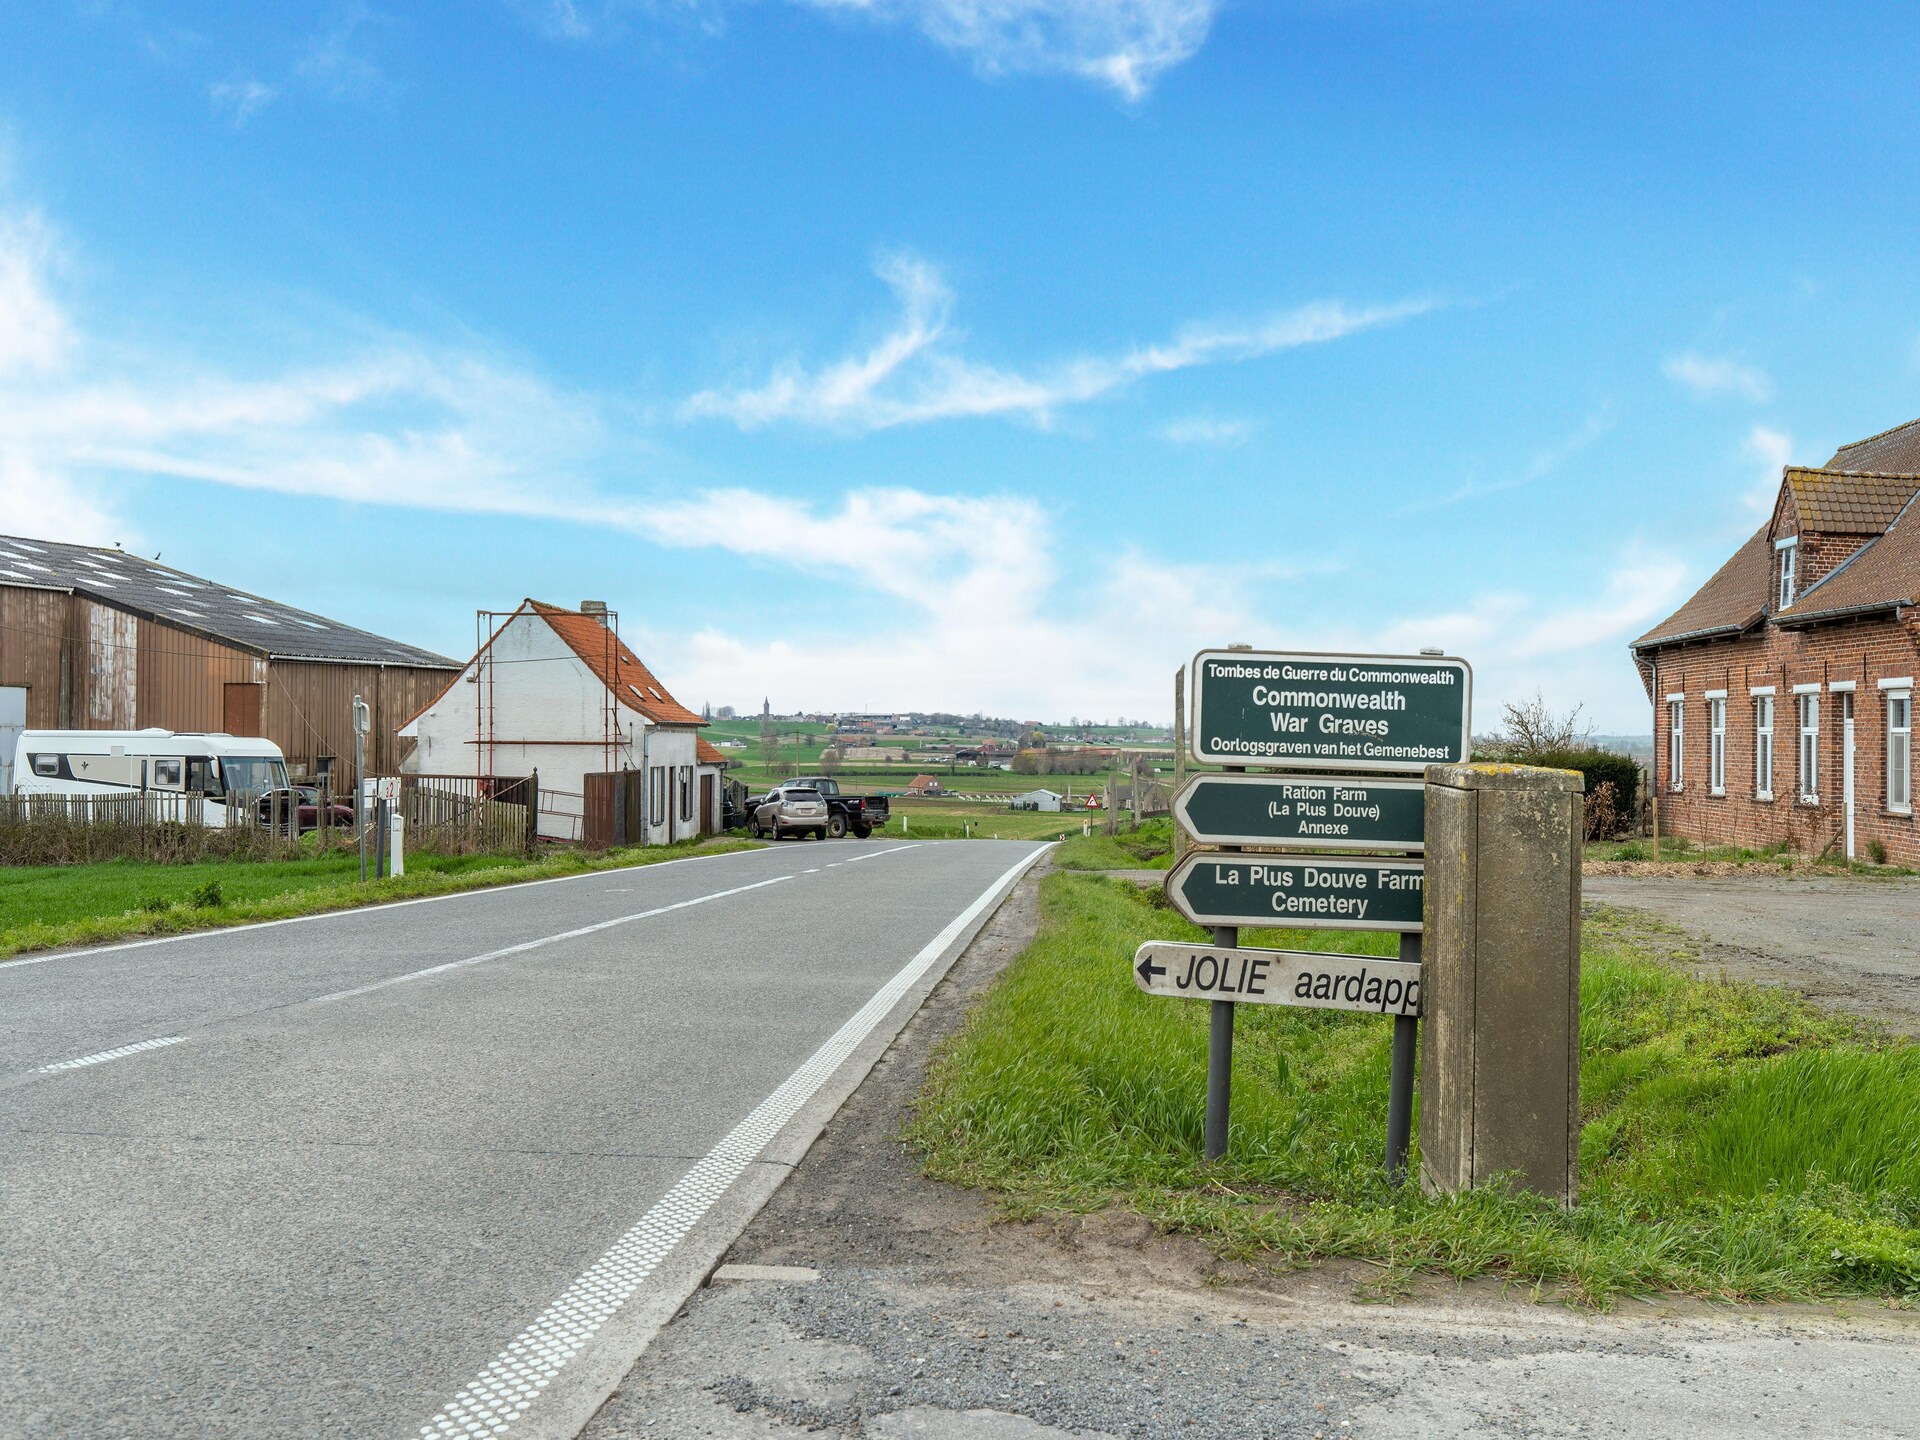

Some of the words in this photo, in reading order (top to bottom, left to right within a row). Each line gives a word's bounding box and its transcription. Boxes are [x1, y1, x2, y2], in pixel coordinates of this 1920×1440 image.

[1209, 664, 1260, 678] Tombes
[1264, 665, 1280, 679] de
[1282, 666, 1327, 681] Guerre
[1330, 667, 1346, 681] du
[1349, 668, 1454, 685] Commonwealth
[1252, 685, 1406, 711] Commonwealth
[1270, 712, 1308, 732] War
[1319, 714, 1389, 735] Graves
[1211, 737, 1311, 756] Oorlogsgraven
[1314, 744, 1341, 756] van
[1342, 742, 1361, 756] het
[1363, 743, 1449, 759] Gemenebest
[1282, 785, 1326, 800] Ration
[1333, 787, 1367, 801] Farm
[1268, 801, 1289, 818] (La
[1297, 803, 1327, 816] Plus
[1334, 804, 1380, 821] Douve)
[1298, 820, 1349, 835] Annexe
[1215, 865, 1239, 885] La
[1250, 867, 1293, 887] Plus
[1304, 868, 1367, 889] Douve
[1378, 870, 1424, 891] Farm
[1271, 892, 1368, 919] Cemetery
[1176, 955, 1270, 995] JOLIE
